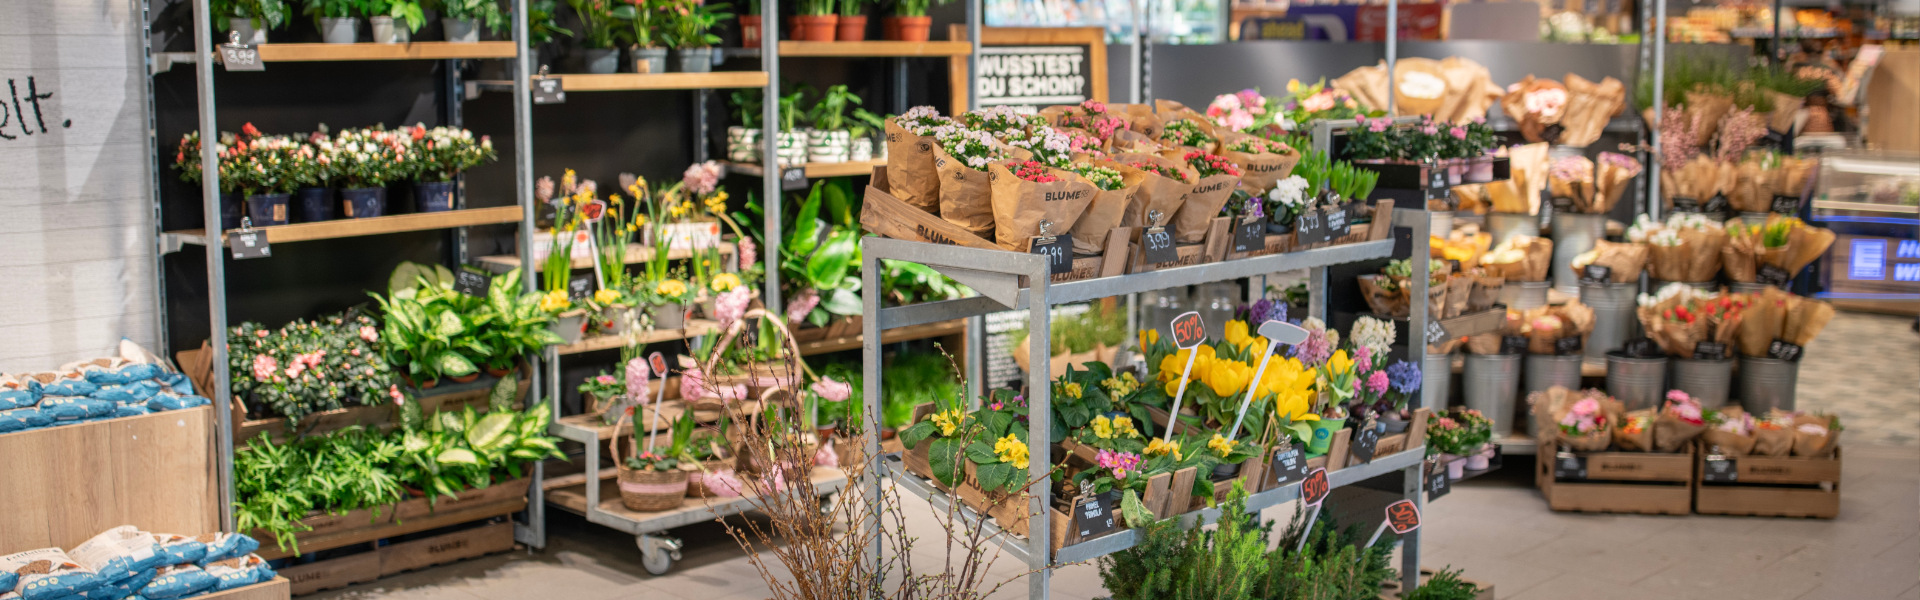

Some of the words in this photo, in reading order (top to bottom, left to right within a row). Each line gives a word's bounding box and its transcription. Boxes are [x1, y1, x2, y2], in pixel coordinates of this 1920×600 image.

[979, 54, 1083, 77] WUSSTEST
[979, 76, 1006, 97] DU
[1192, 182, 1223, 194] LUME
[1147, 231, 1170, 251] 3,99
[1175, 314, 1203, 343] 50%
[1304, 471, 1328, 502] 50%
